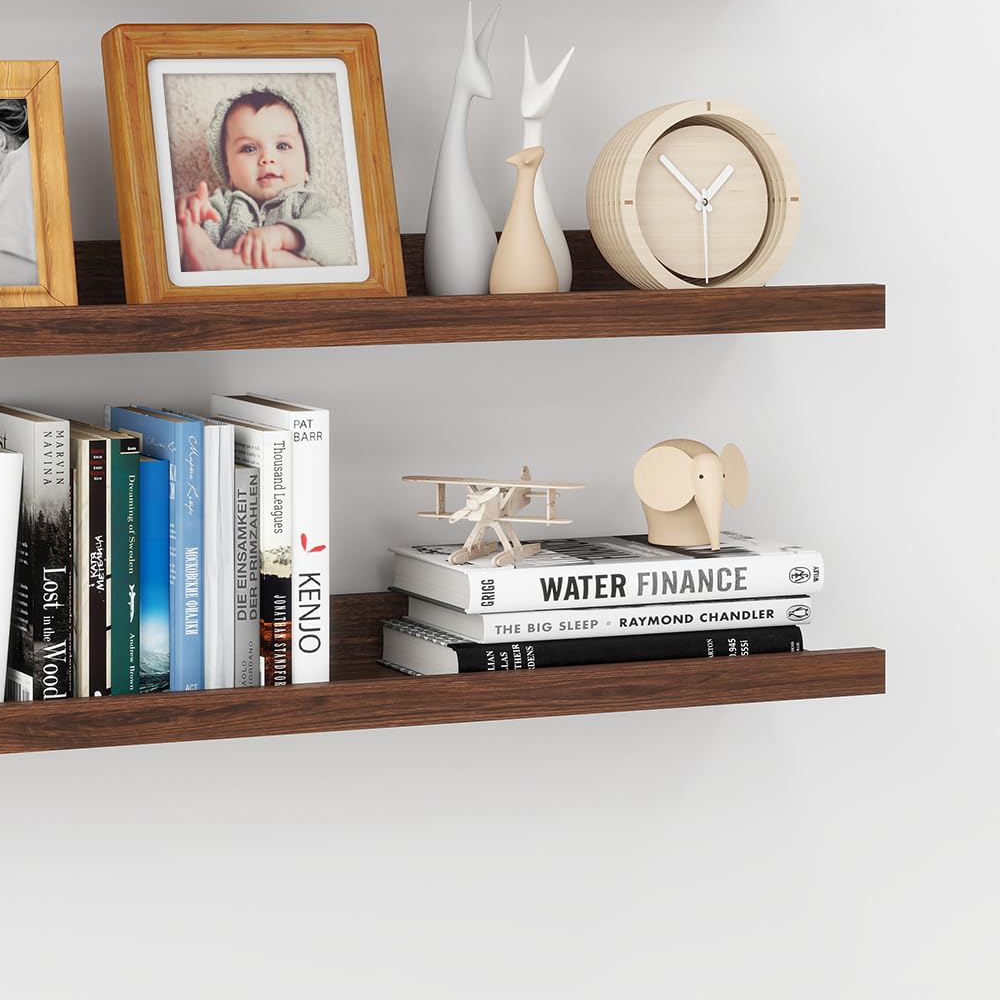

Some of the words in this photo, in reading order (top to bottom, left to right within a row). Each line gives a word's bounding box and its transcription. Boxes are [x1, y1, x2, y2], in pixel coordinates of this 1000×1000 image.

[293, 419, 314, 429] PAT
[293, 431, 323, 442] BARR
[43, 431, 52, 485] NAVINA
[56, 430, 65, 485] MARVIN
[273, 440, 286, 491] Thousand
[127, 475, 136, 523] Dreaming
[270, 493, 286, 534] Leagues
[128, 524, 136, 534] of
[237, 489, 248, 588] EINSAMKEIT
[249, 474, 258, 581] PRIMZAHLEN
[128, 536, 136, 574] Sweden
[185, 547, 199, 598] МОСКОВСКИЕ
[812, 566, 820, 583] WILEY
[43, 566, 67, 611] Lost
[249, 586, 258, 620] DER
[481, 579, 495, 607] GRIGG
[540, 573, 627, 601] WATER
[637, 566, 748, 597] FINANCE
[43, 616, 55, 625] in
[185, 600, 199, 635] ФИАЛКИ
[237, 594, 247, 621] DIE
[273, 594, 287, 639] JONATHAN
[298, 573, 321, 654] KENJO
[495, 624, 521, 634] THE
[528, 622, 552, 633] BIG
[559, 619, 599, 631] SLEEP
[619, 614, 694, 627] RAYMOND
[700, 609, 775, 623] CHANDLER
[43, 627, 56, 642] the
[43, 639, 67, 700] Wood
[273, 642, 287, 686] STANDFOR
